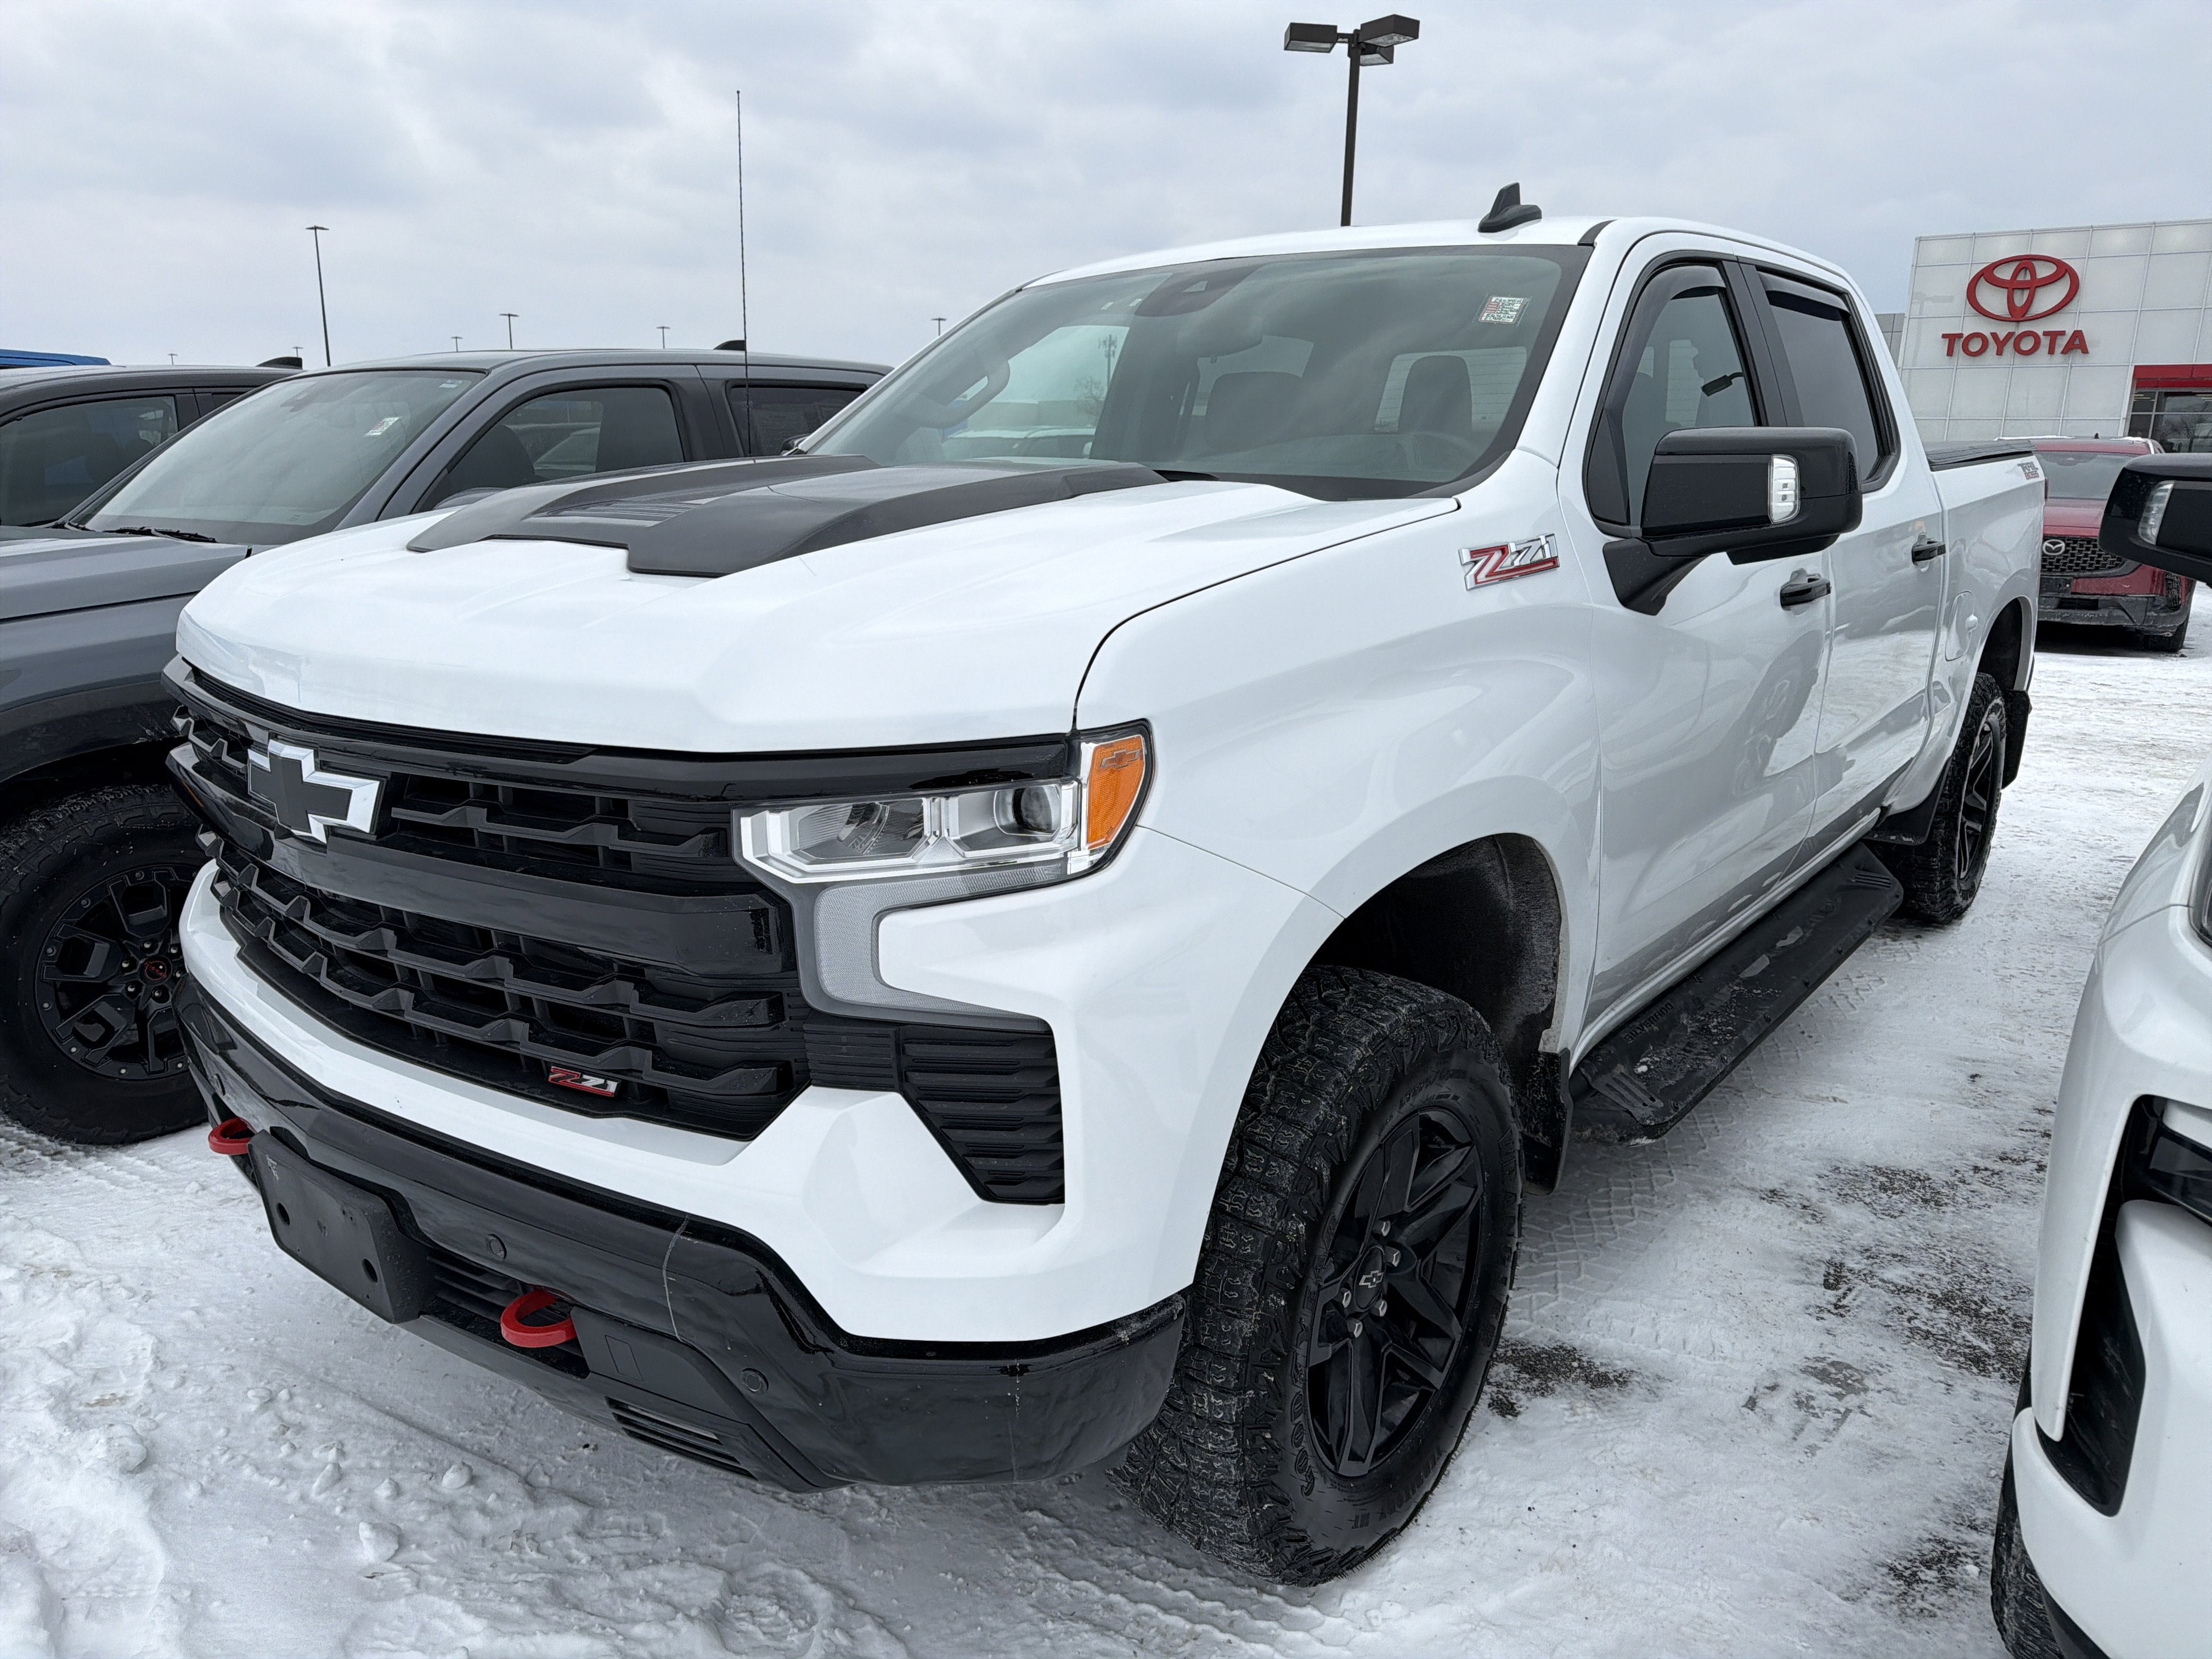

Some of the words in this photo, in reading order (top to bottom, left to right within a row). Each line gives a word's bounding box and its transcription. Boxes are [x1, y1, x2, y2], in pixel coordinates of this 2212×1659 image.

[1941, 329, 2090, 357] TOYOTA
[2017, 461, 2039, 473] TRAIL
[2024, 470, 2040, 480] BOSS
[1458, 533, 1560, 591] Z71
[1624, 1002, 1674, 1042] SILVERADO
[548, 1066, 620, 1097] Z71
[1289, 1211, 1338, 1498] GOODYEAR
